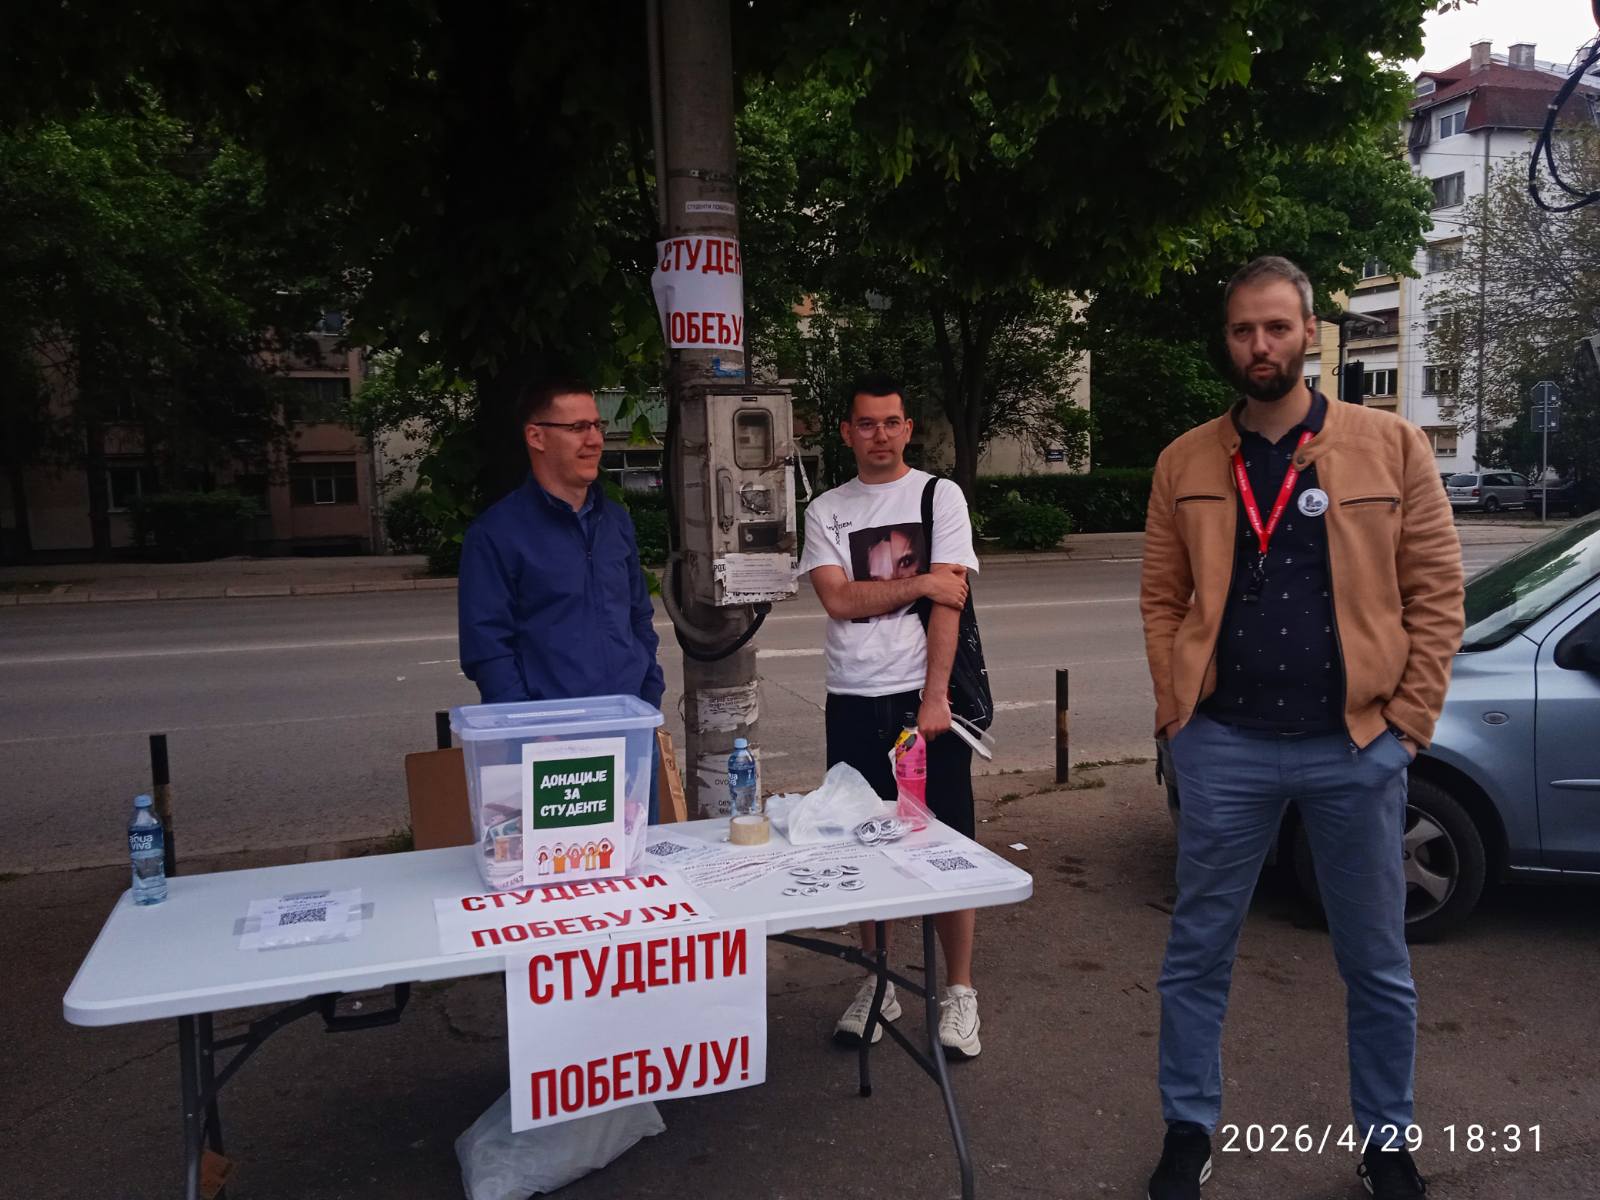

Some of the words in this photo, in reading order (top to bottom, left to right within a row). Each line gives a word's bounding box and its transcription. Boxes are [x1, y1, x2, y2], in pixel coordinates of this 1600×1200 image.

[540, 769, 608, 789] ДОНАЦИЈЕ
[563, 787, 581, 801] ЗА
[540, 799, 607, 817] СТУДЕНТЕ
[460, 873, 669, 912] СТУДЕНТИ
[471, 901, 699, 948] ПОБЕЂУЈУ!
[528, 928, 748, 1005] СТУДЕНТИ
[531, 1035, 750, 1120] ПОБЕЂУЈУ!
